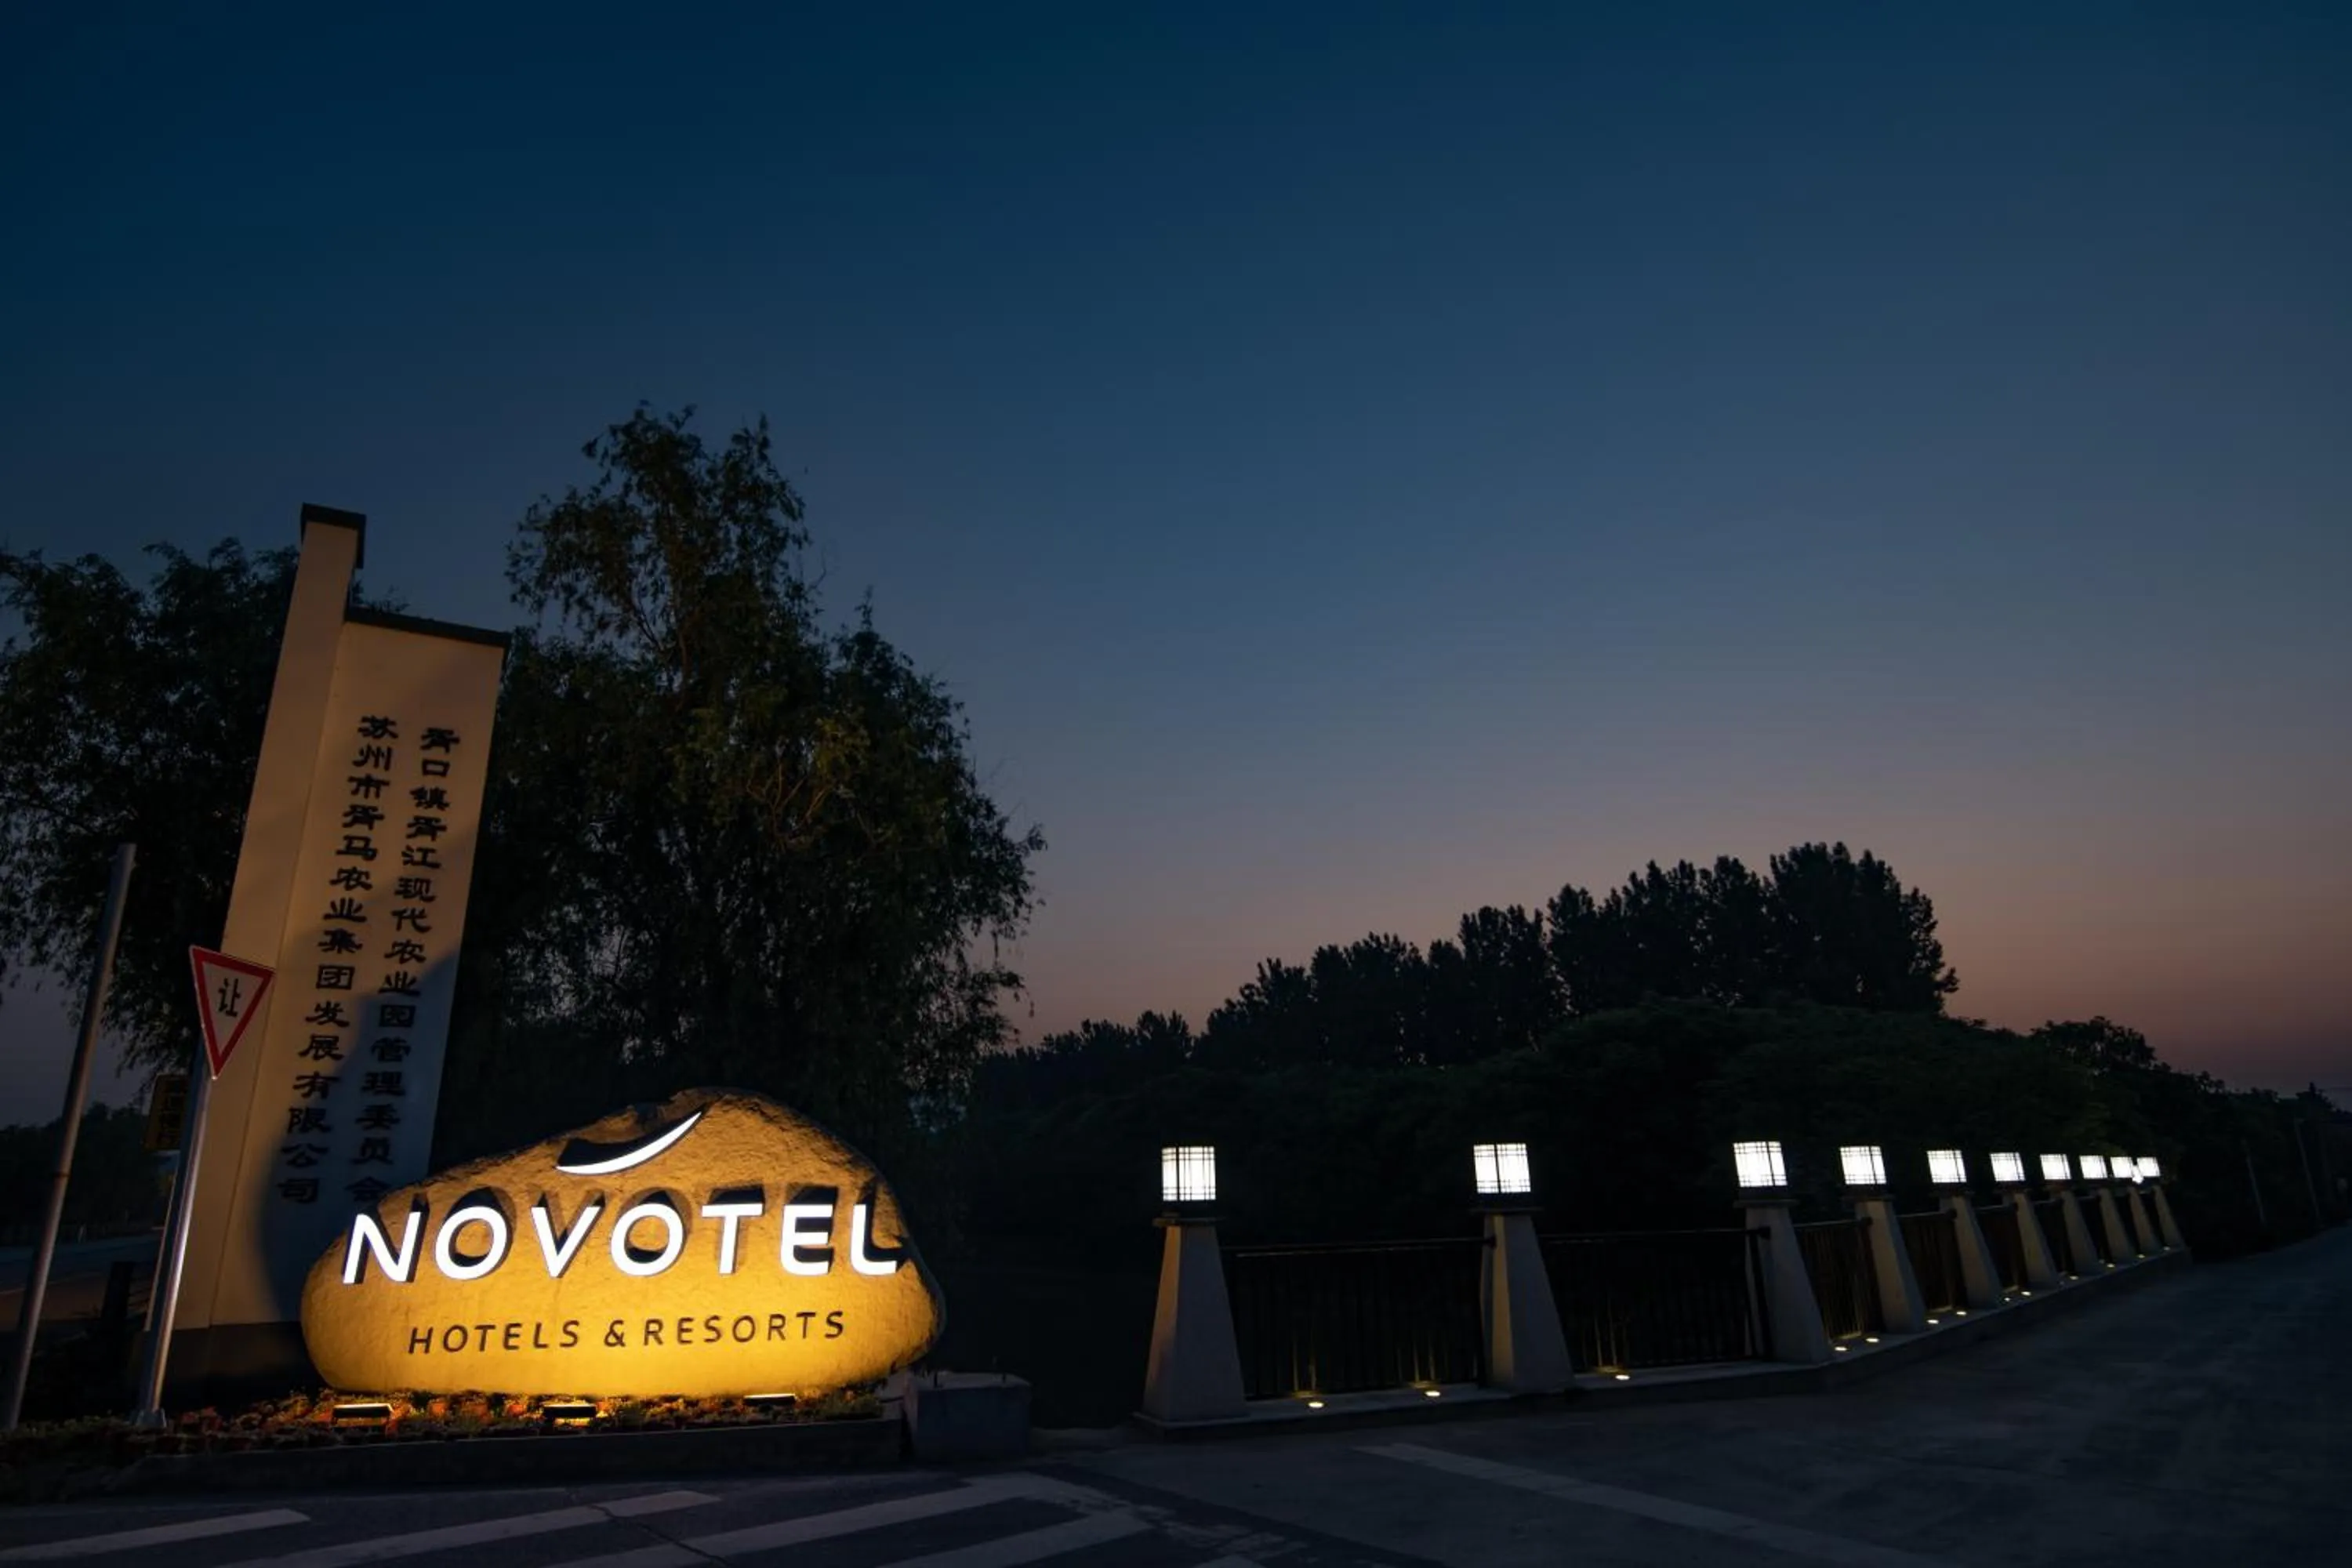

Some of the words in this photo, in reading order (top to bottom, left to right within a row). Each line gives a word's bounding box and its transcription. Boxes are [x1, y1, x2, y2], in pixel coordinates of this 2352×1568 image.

[218, 978, 240, 1017] 让
[342, 1202, 898, 1285] NOVOTEL
[408, 1319, 580, 1356] HOTELS
[603, 1318, 626, 1347] &
[643, 1310, 846, 1345] RESORTS
